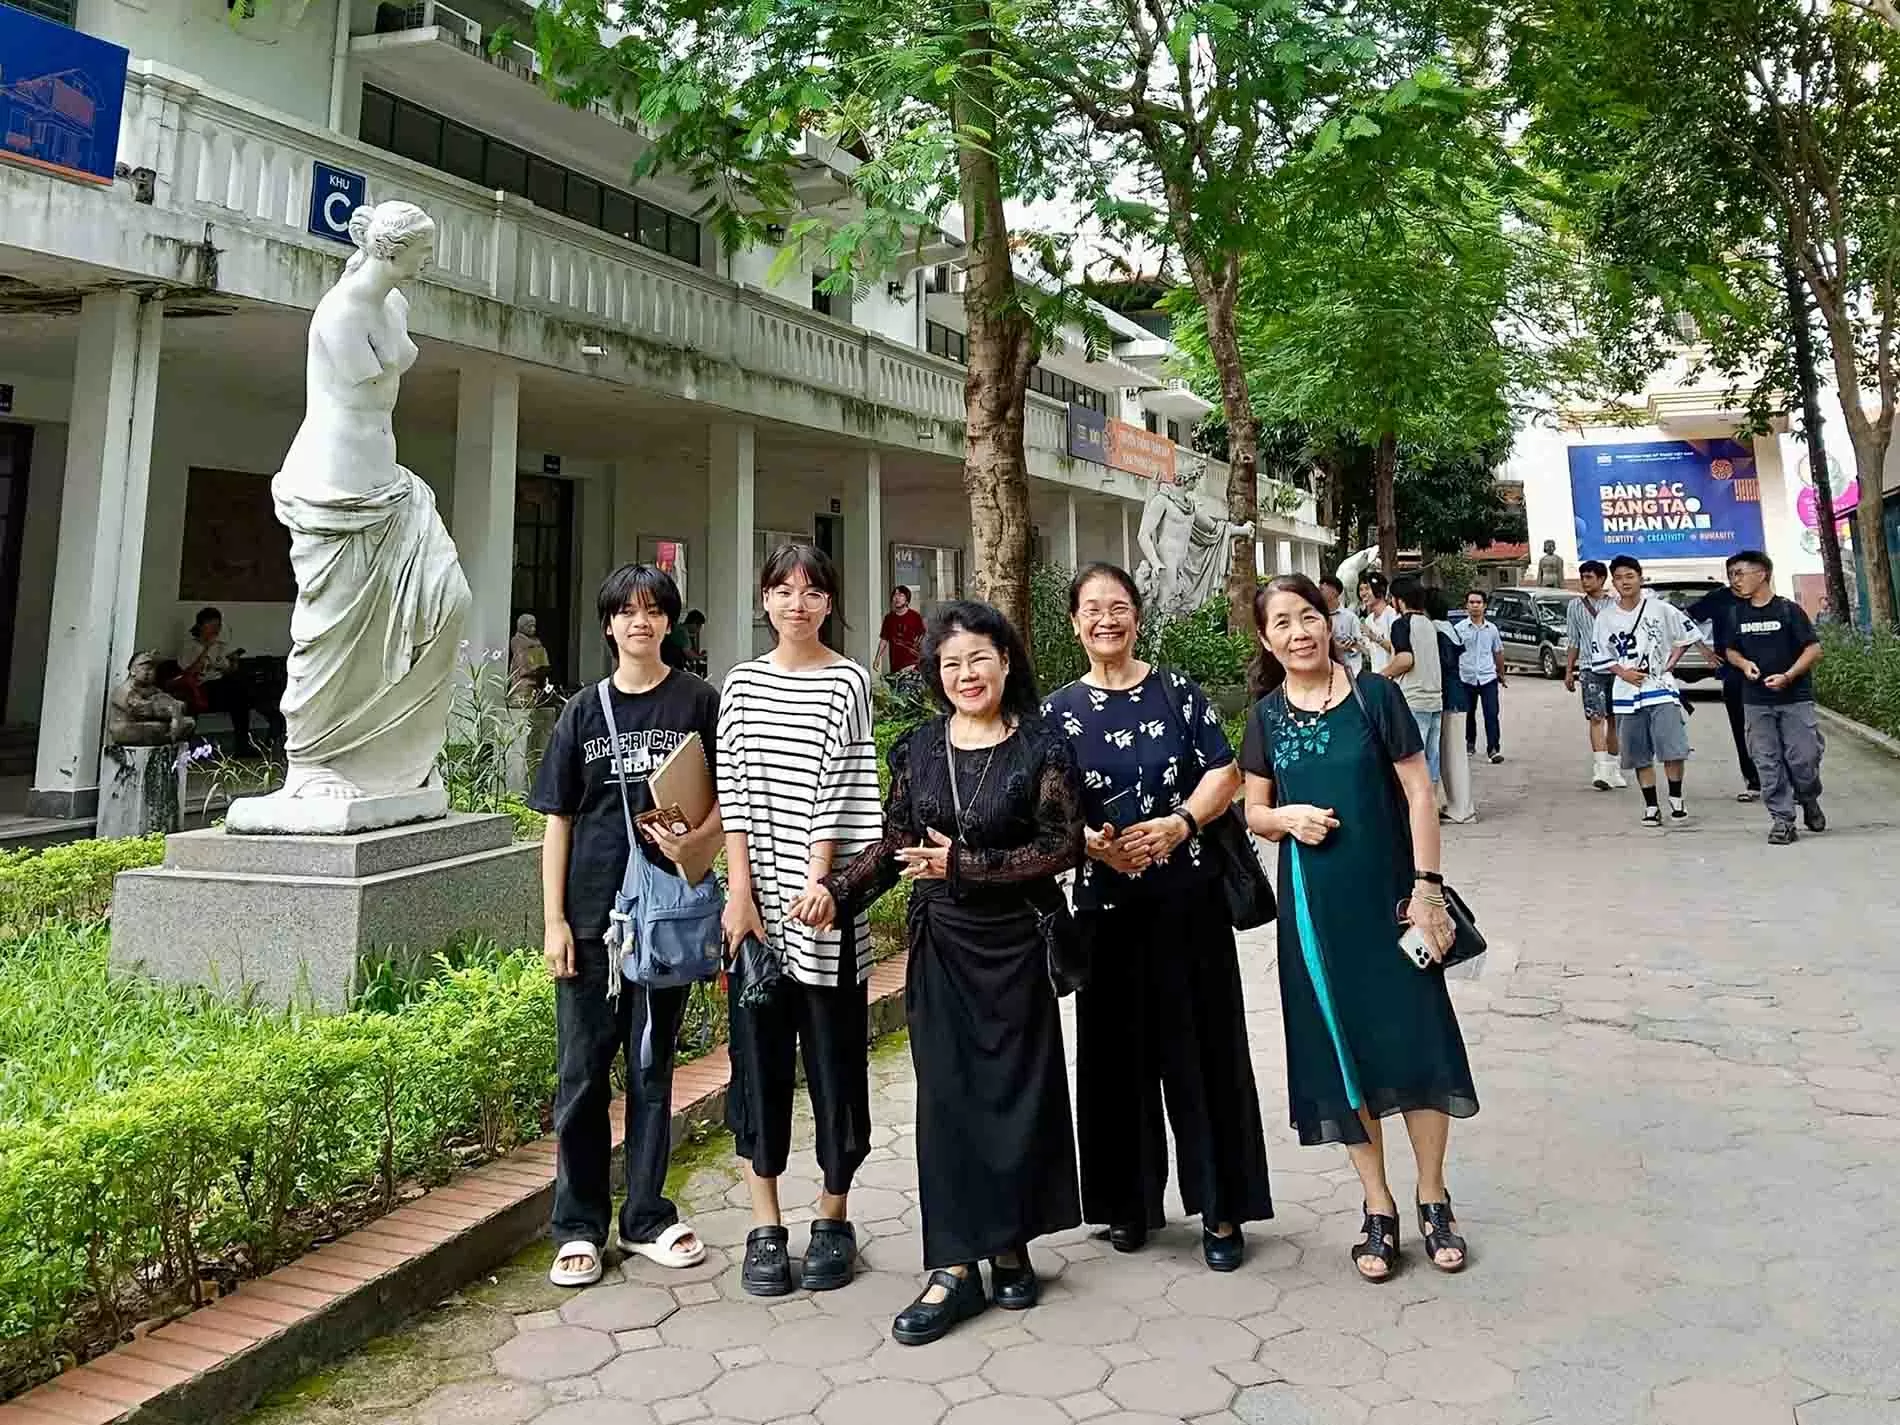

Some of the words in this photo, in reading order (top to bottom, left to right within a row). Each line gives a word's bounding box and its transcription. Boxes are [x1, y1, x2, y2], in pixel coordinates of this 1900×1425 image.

[329, 174, 350, 190] KHU
[324, 191, 351, 232] C
[1600, 498, 1658, 516] SÁNG
[1647, 533, 1686, 542] CREATIVITY
